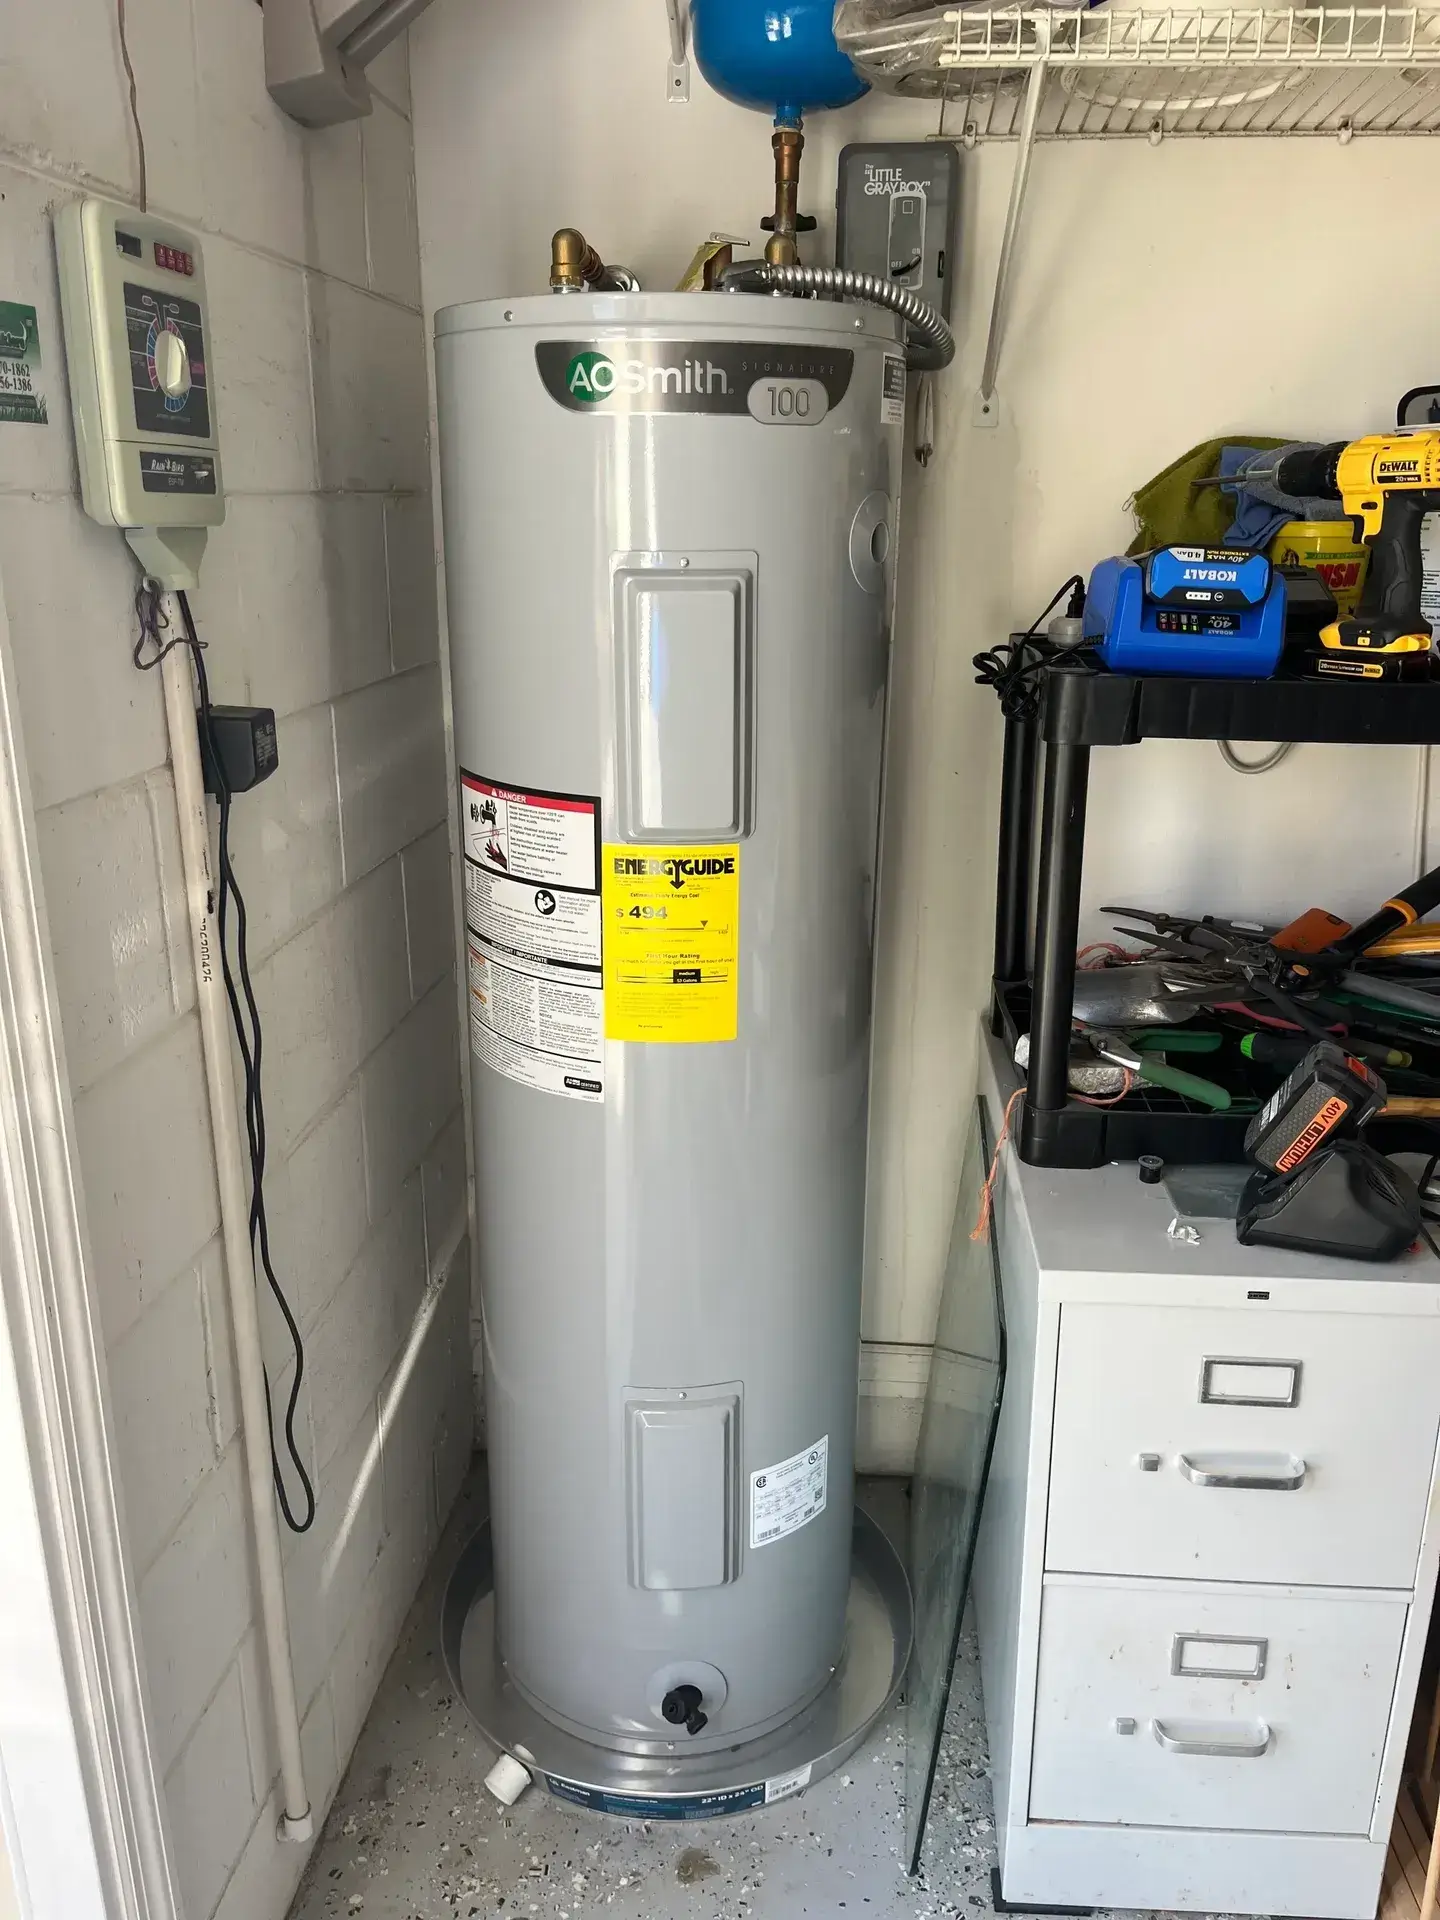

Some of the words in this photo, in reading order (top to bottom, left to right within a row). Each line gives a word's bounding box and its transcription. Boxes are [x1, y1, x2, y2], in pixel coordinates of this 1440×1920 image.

[864, 182, 898, 195] GRAY
[767, 387, 811, 417] 100
[1183, 569, 1237, 582] KOBALT
[499, 790, 526, 803] DANGER
[614, 858, 735, 876] ENERGYGUIDE
[616, 908, 624, 918] $
[629, 906, 667, 919] 494
[1321, 1101, 1341, 1124] 40V
[1281, 1122, 1326, 1169] LITHIUM
